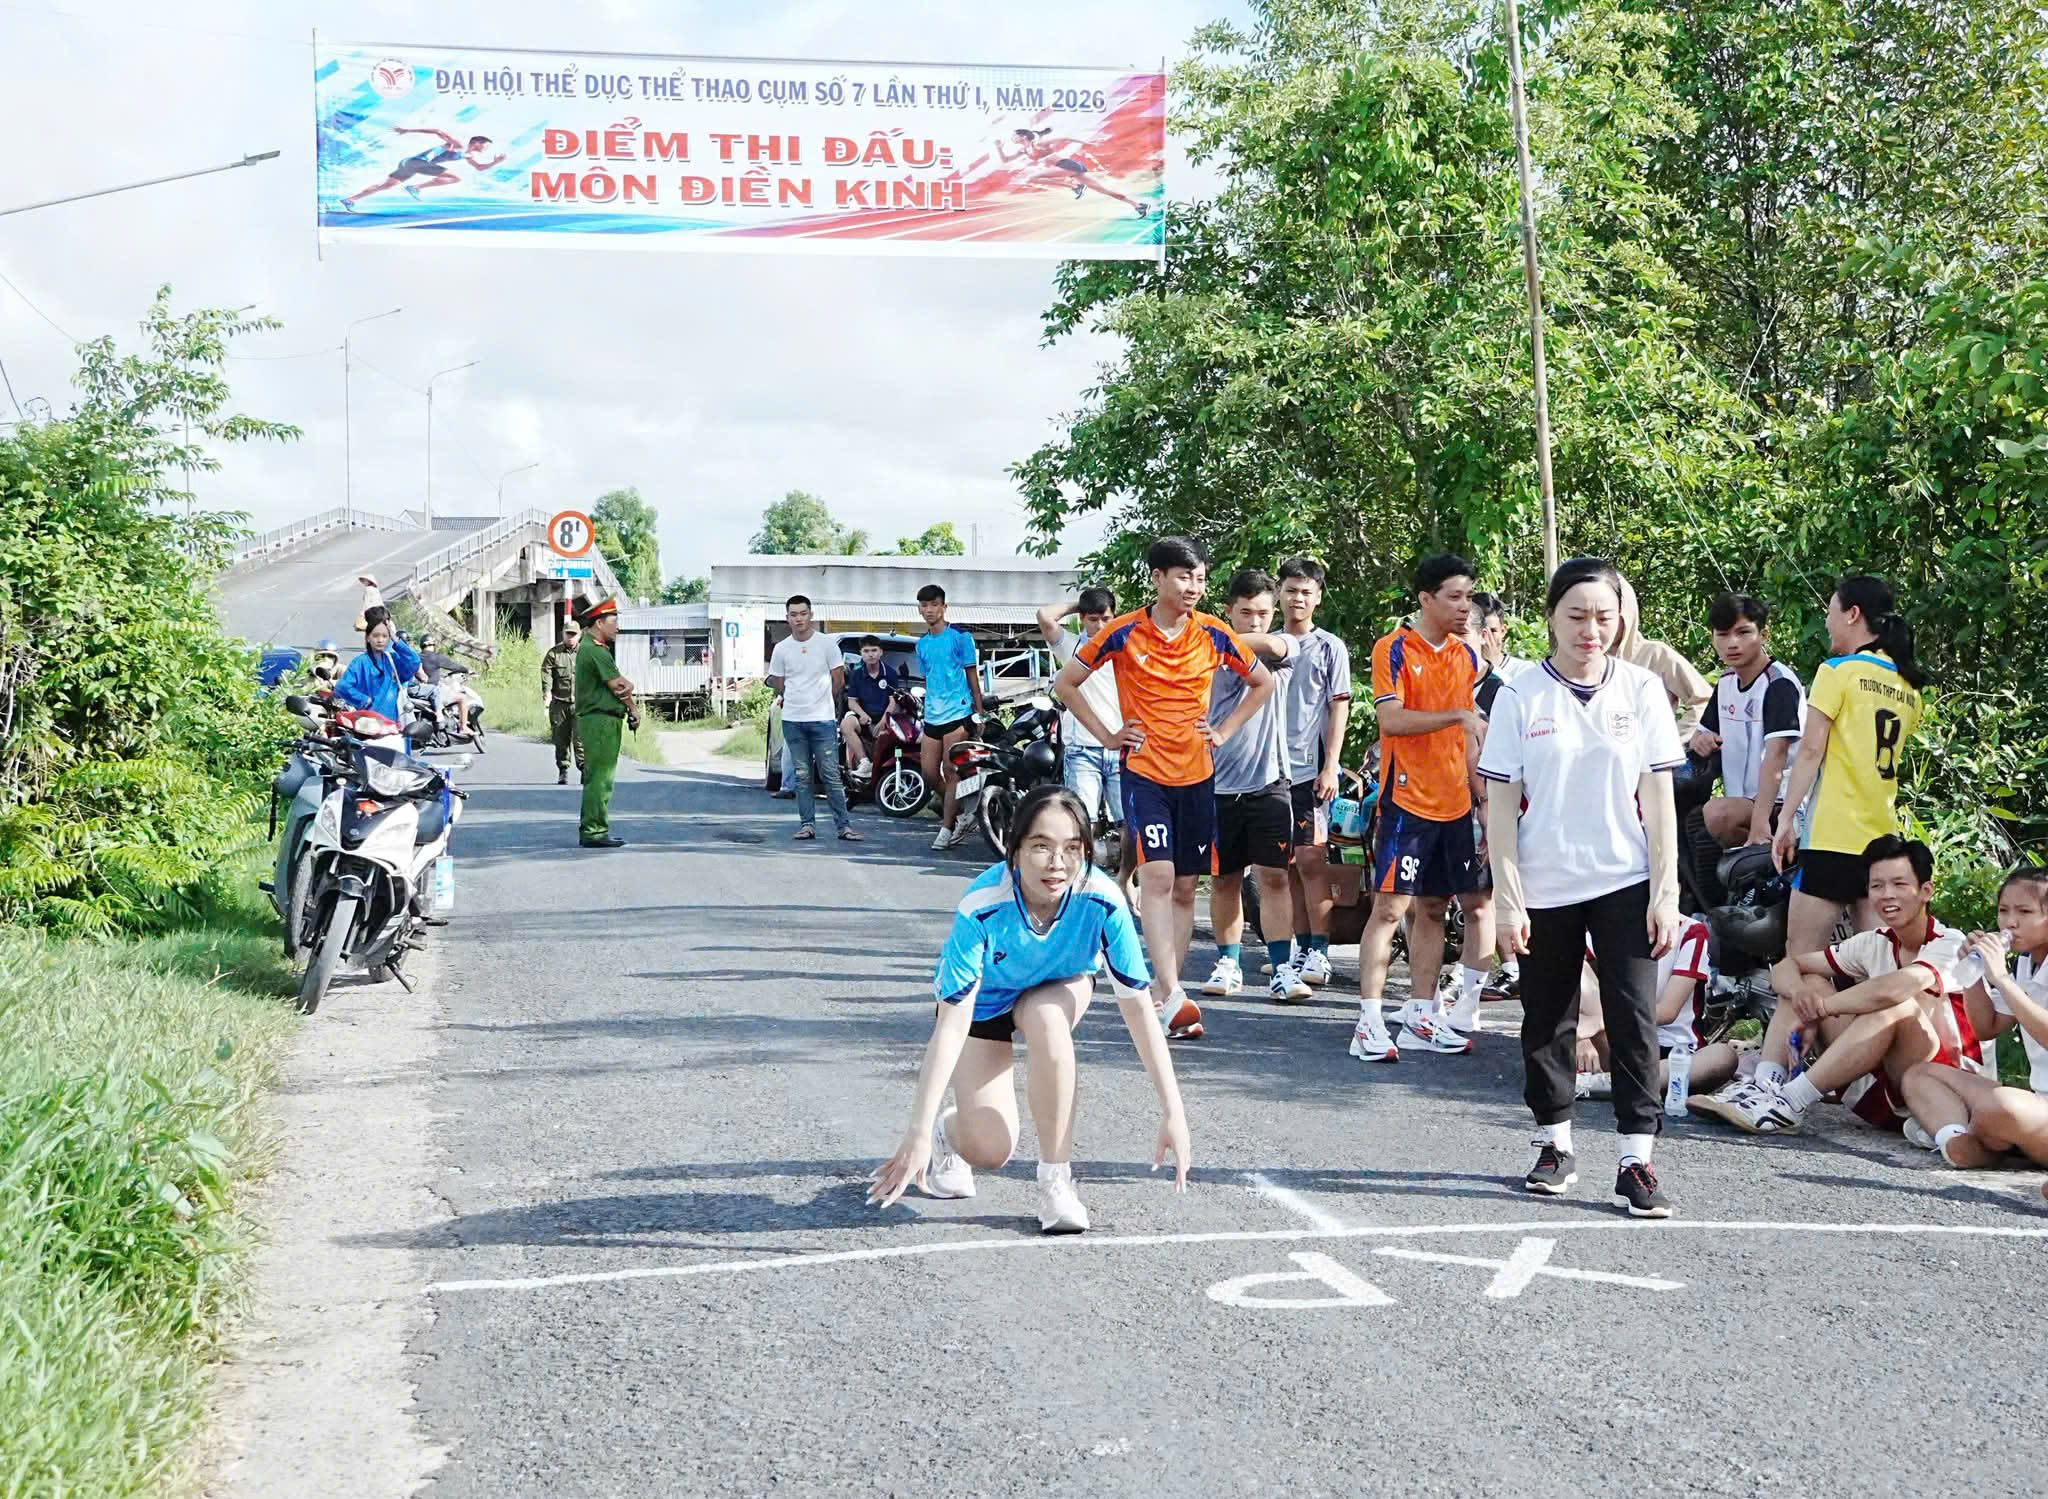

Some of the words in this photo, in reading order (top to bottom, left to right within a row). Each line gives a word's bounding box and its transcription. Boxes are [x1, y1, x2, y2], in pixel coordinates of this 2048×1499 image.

[435, 69, 475, 96] ĐẠI
[483, 66, 523, 98] HỘI
[530, 63, 579, 97] THỂ
[584, 73, 632, 102] DỤC
[638, 66, 686, 100] THỂ
[691, 77, 751, 103] THAO
[758, 79, 808, 107] CỤM
[815, 75, 847, 105] SỐ
[852, 82, 866, 105] 7
[873, 75, 917, 107] LẦN
[923, 81, 970, 108] THỨ
[996, 84, 1045, 111] NĂM
[1051, 89, 1106, 112] 2026
[542, 116, 690, 162] ĐIỂM
[709, 134, 802, 165] THI
[822, 128, 952, 168] ĐẤU:
[531, 166, 658, 203] MÔN
[679, 166, 812, 208] ĐIỀN
[836, 179, 964, 211] KINH
[1875, 708, 1900, 779] 8
[1145, 823, 1168, 848] 97
